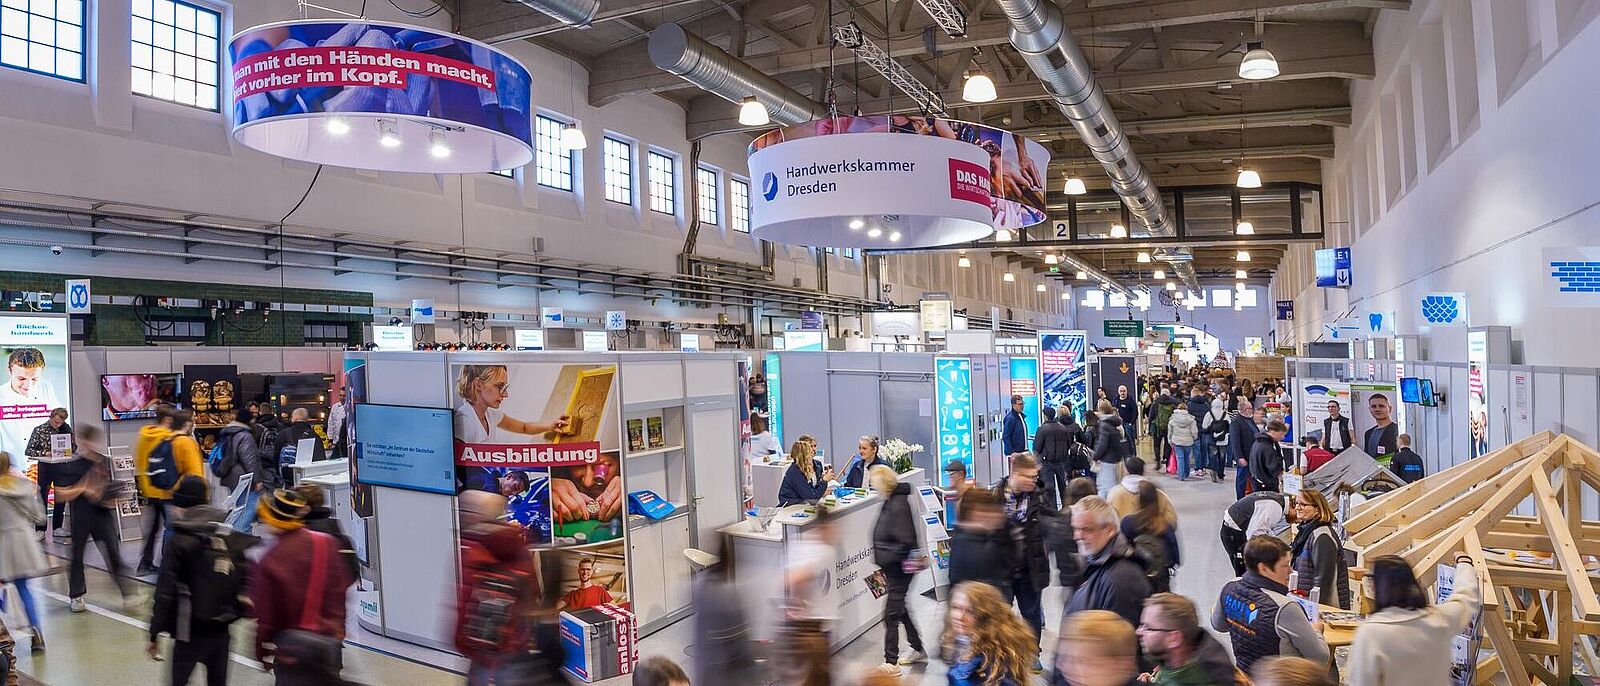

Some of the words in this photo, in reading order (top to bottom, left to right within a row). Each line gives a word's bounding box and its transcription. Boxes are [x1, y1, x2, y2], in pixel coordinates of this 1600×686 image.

[254, 55, 280, 73] mit
[284, 53, 323, 67] den
[329, 50, 420, 70] Händen
[427, 61, 493, 88] macht,
[249, 72, 300, 91] vorher
[306, 69, 334, 82] im
[341, 67, 403, 85] Kopf.
[786, 159, 916, 179] Handwerkskammer
[956, 169, 977, 185] DAS
[787, 180, 837, 197] Dresden
[1056, 223, 1067, 237] 2
[461, 447, 598, 464] Ausbildung
[836, 570, 858, 590] Dresden
